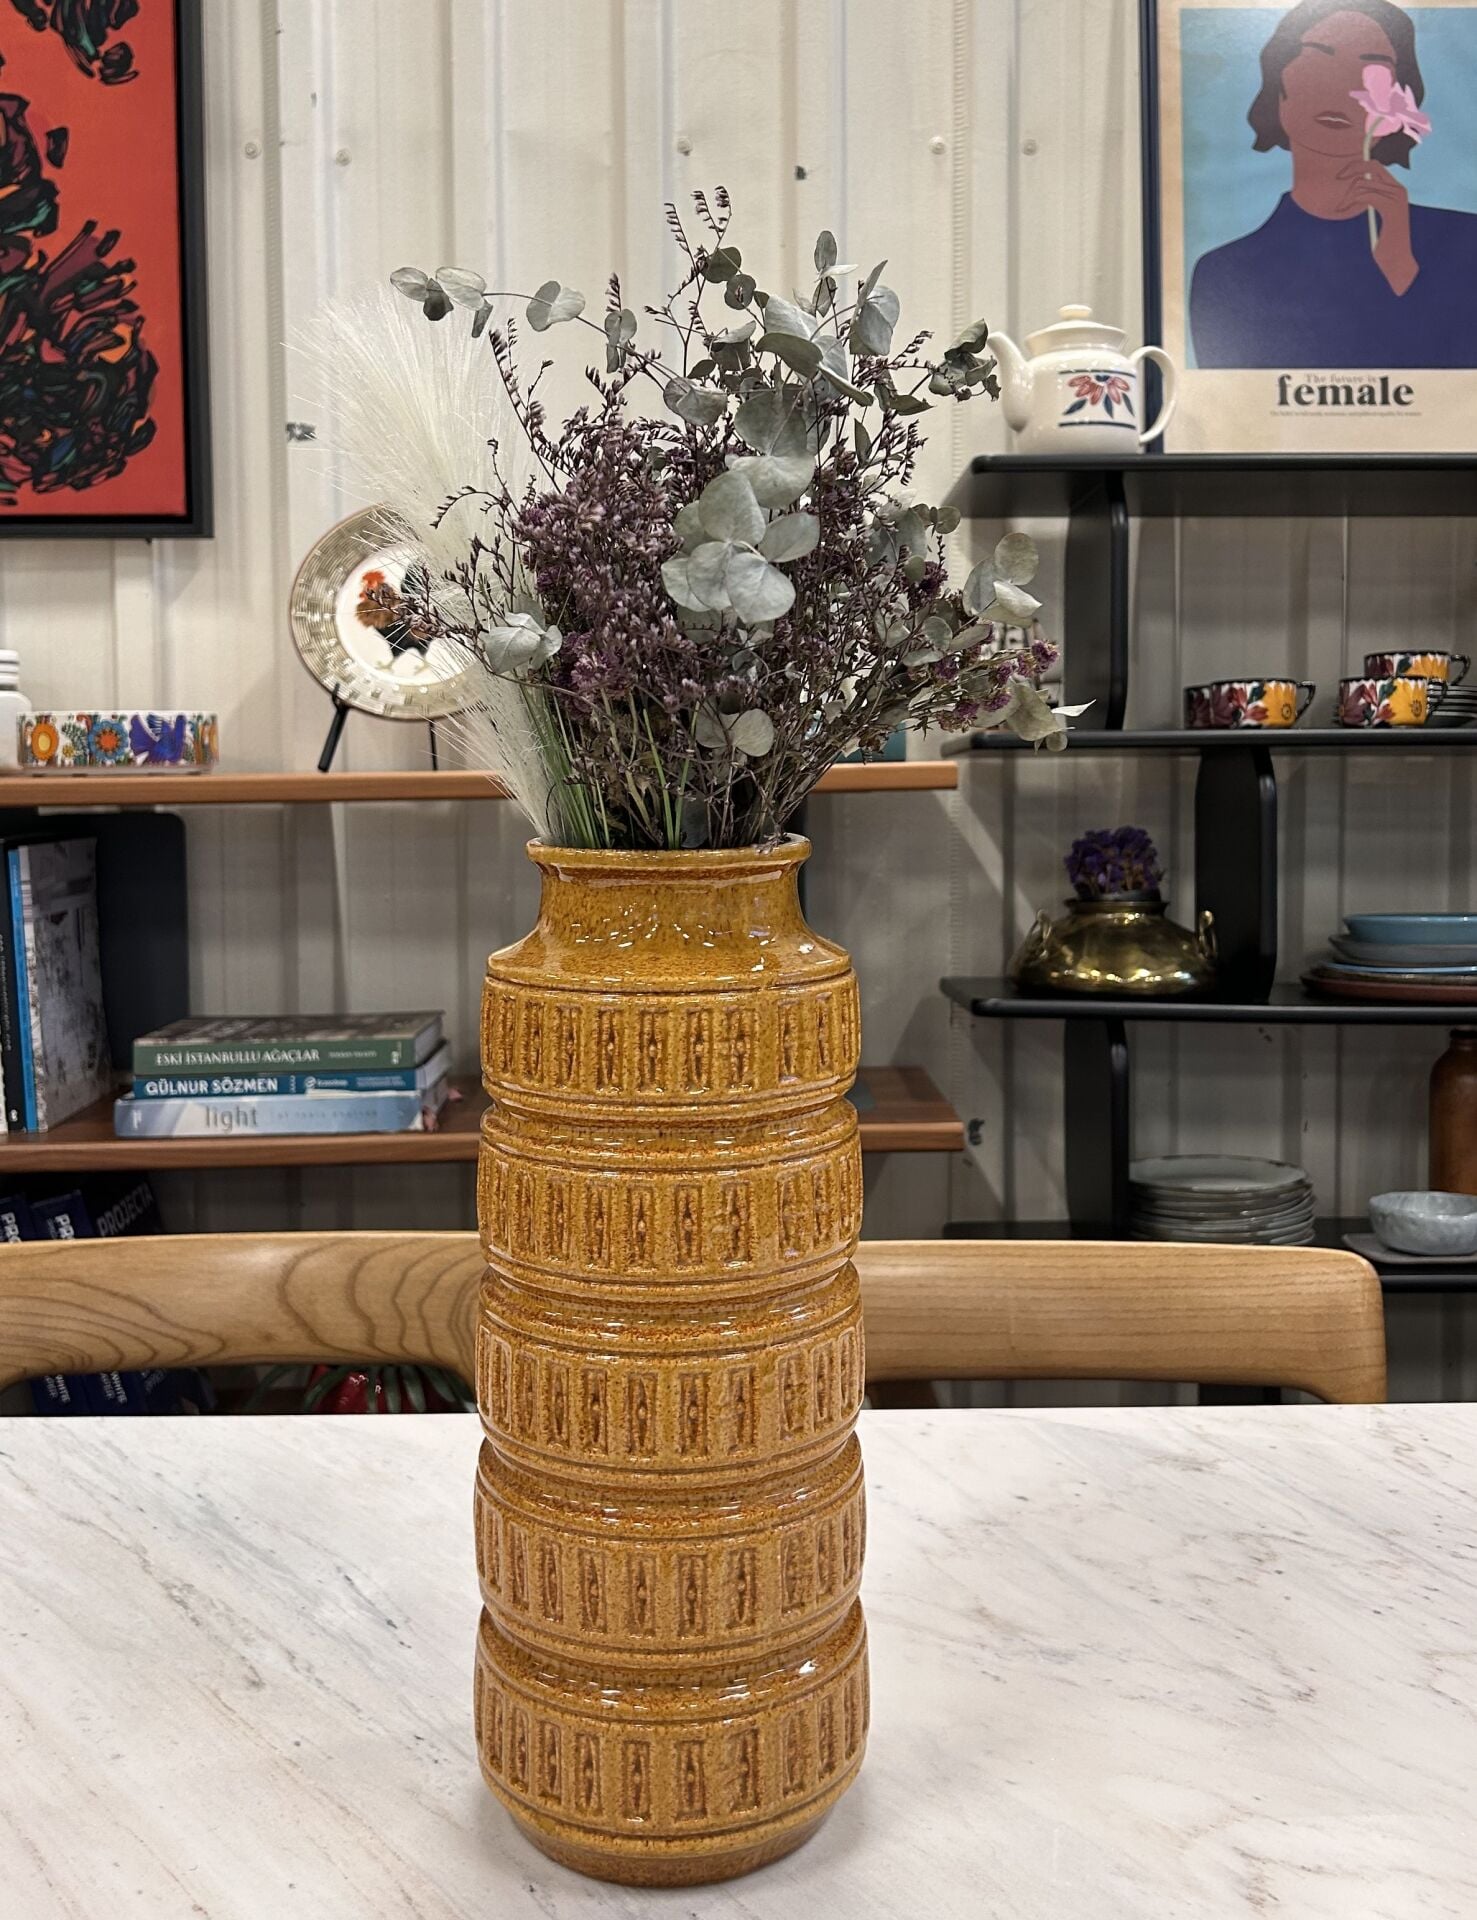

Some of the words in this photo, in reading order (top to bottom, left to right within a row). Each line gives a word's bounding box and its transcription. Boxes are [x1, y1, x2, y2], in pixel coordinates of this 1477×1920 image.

[1305, 373, 1327, 384] The
[1330, 373, 1364, 384] future
[1277, 373, 1415, 407] female
[262, 1047, 320, 1064] AĞAÇLAR
[145, 1078, 209, 1097] GÜLNUR
[211, 1075, 279, 1095] SÖZMEN
[205, 1104, 258, 1133] light
